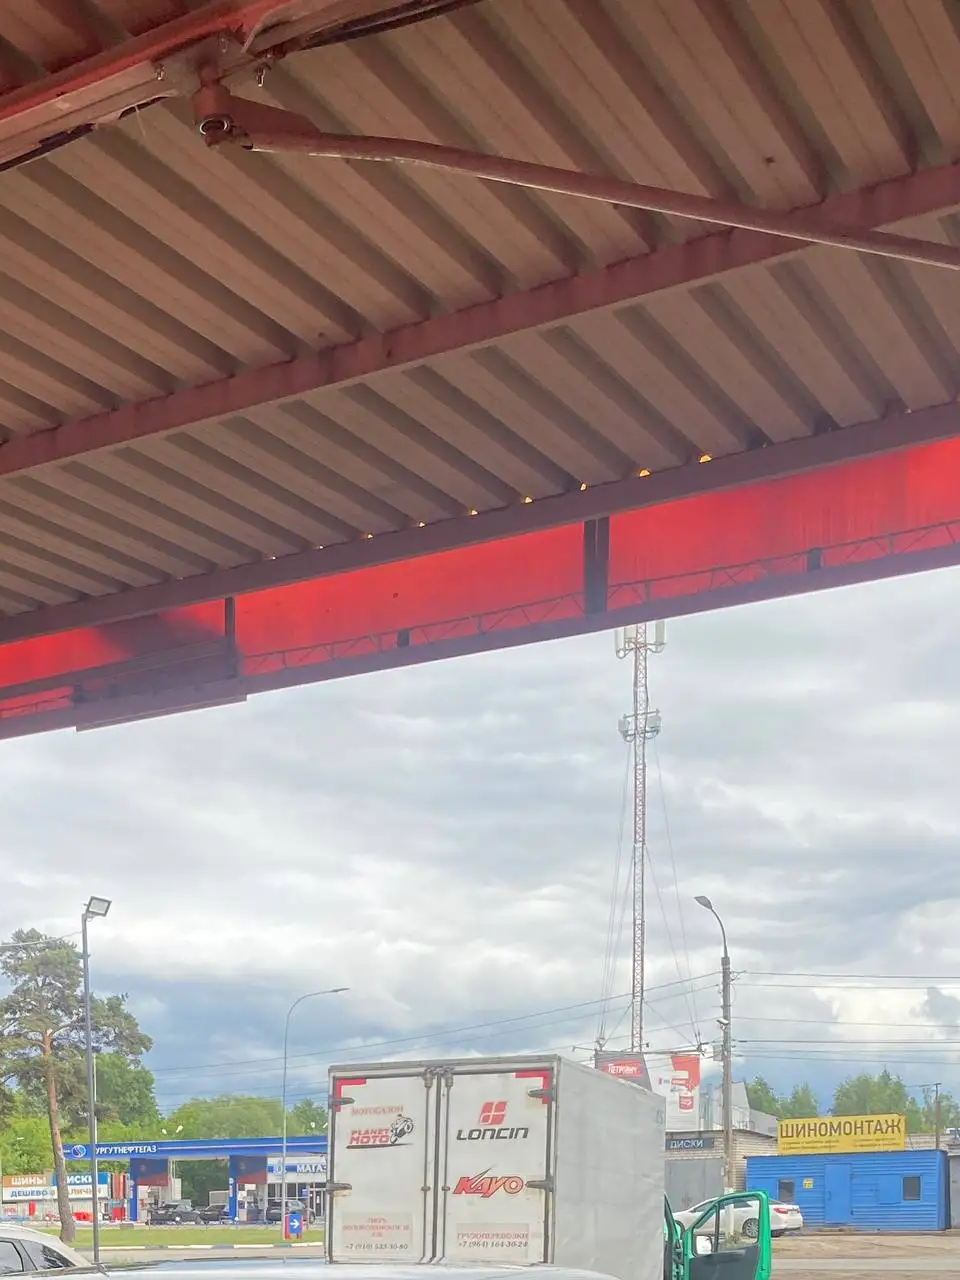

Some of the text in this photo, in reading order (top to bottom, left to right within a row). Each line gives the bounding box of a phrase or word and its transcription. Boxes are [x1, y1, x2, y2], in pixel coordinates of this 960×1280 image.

[351, 1128, 390, 1136] PLANET
[780, 1118, 902, 1138] ШИНОМОНТАЖ
[456, 1127, 529, 1140] LONCIN
[349, 1135, 390, 1144] MOTO
[670, 1139, 704, 1148] ДИСКИ
[94, 1145, 157, 1154] УРГУТНЕФТЕГАЗ
[11, 1176, 47, 1185] ШИНЫ
[10, 1189, 48, 1198] ДЕШЕВО
